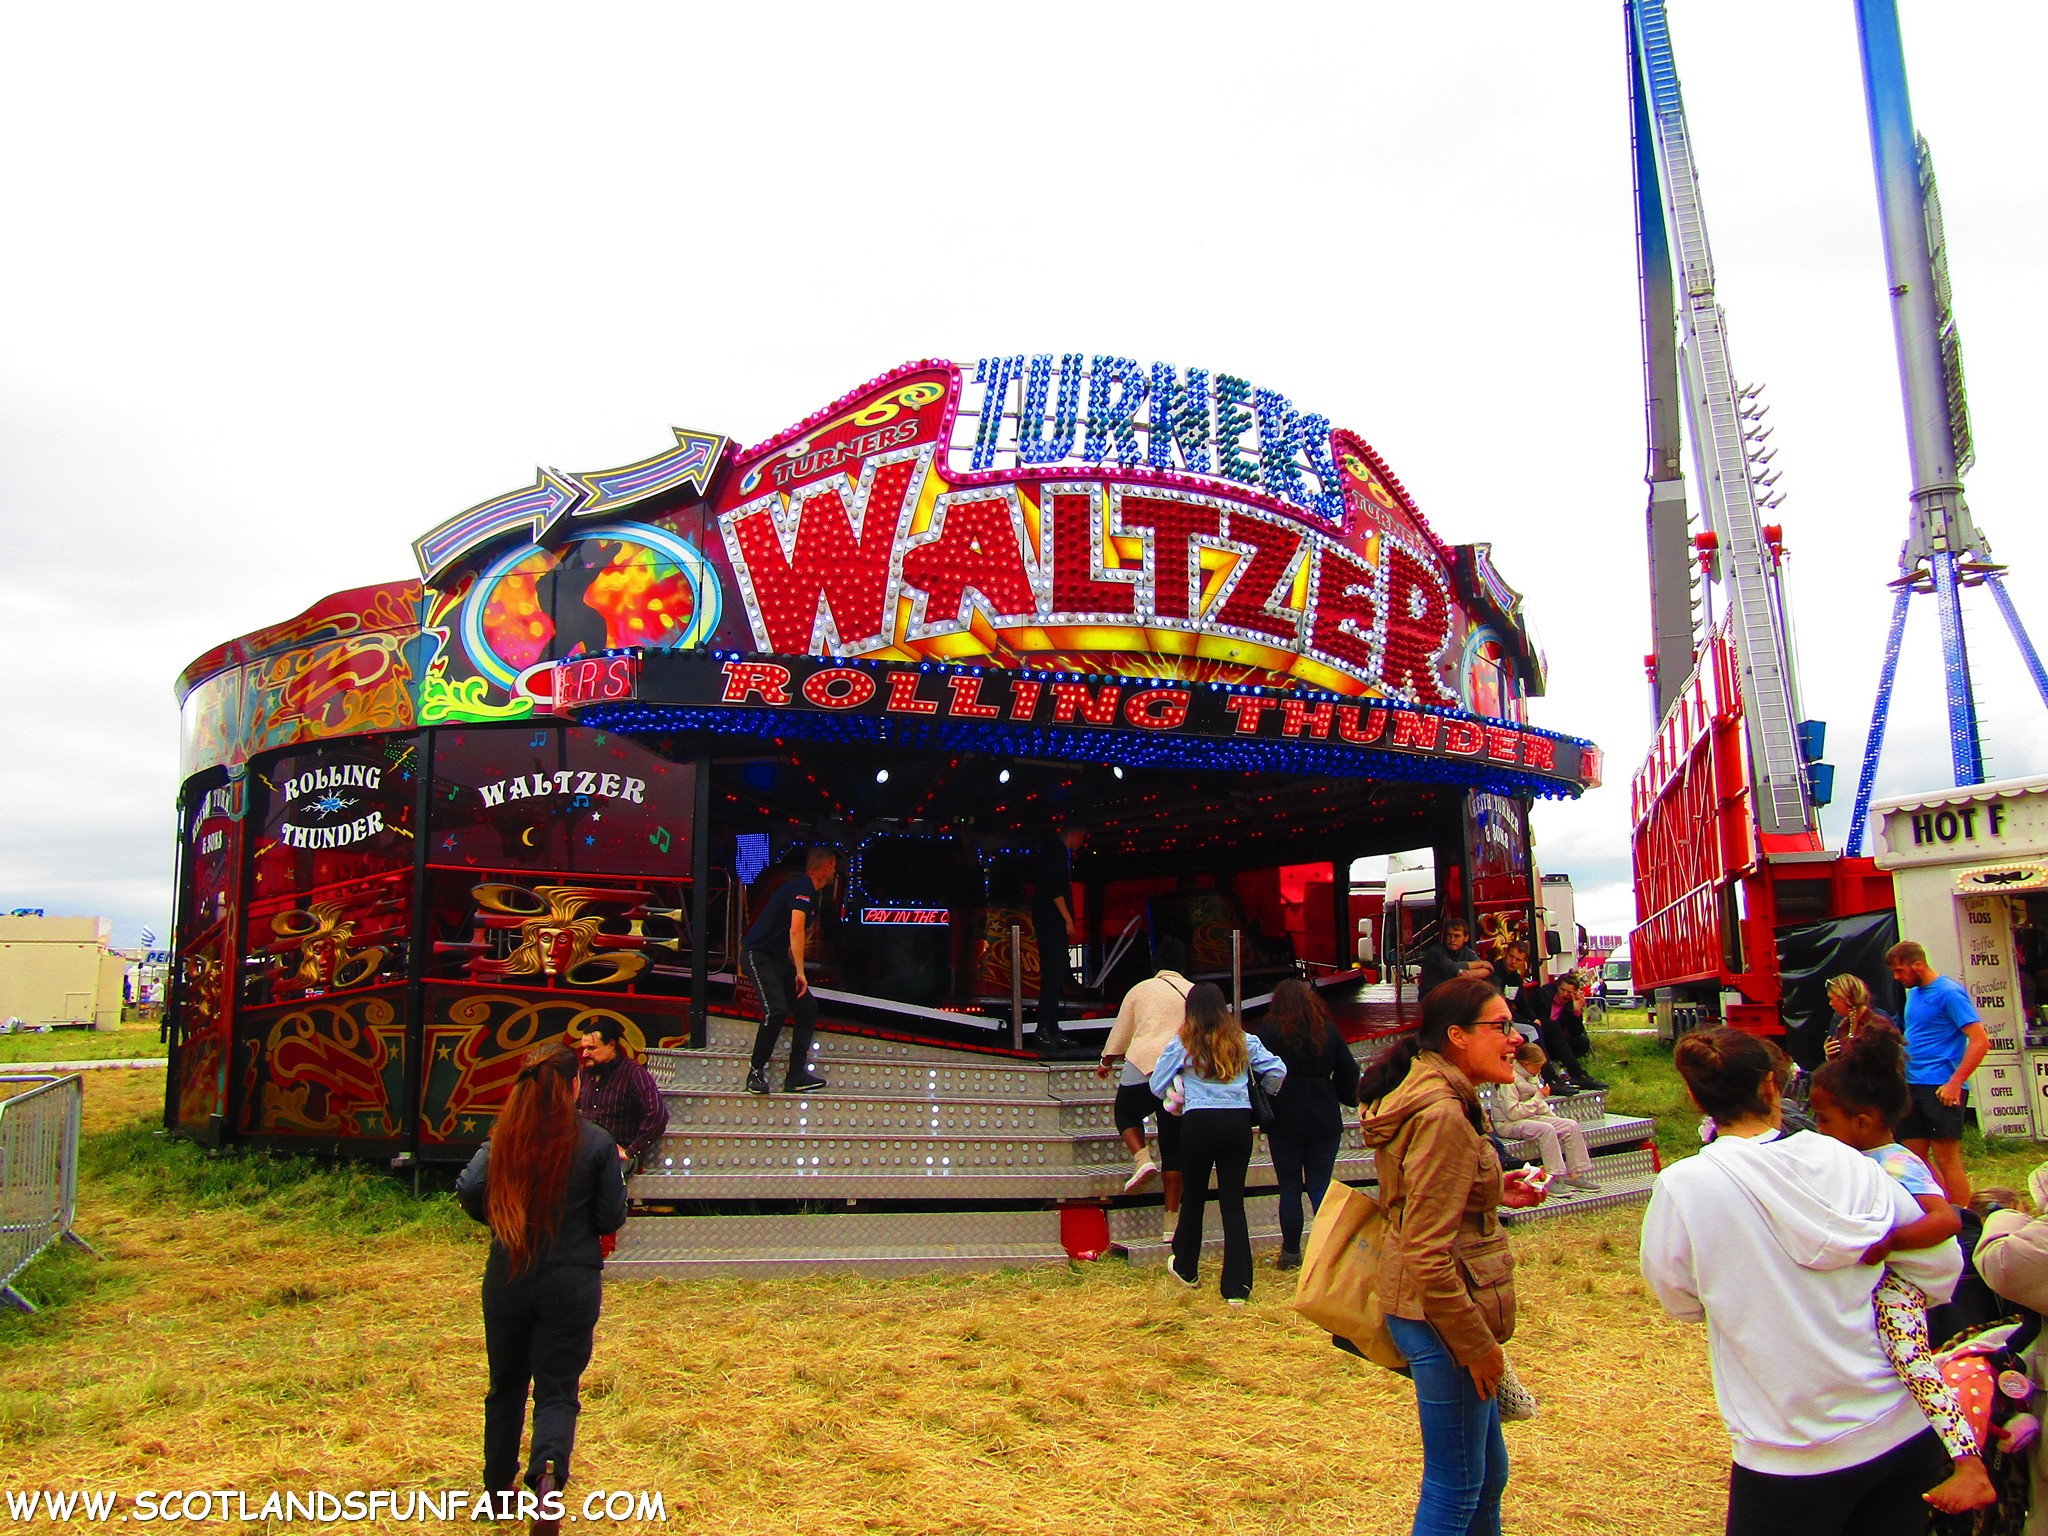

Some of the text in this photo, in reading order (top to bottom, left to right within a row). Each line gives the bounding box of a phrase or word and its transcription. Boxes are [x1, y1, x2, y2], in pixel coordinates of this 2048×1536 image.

[969, 353, 1345, 523] TURNERS
[772, 418, 920, 486] TURNERS
[718, 441, 1466, 710] WALTZER
[721, 661, 1556, 770] ROLLING THUNDER
[284, 764, 381, 802] ROLLING
[478, 770, 646, 808] WALTZER
[282, 811, 384, 849] THUNDER
[1911, 808, 1975, 845] HOT
[865, 910, 891, 923] PAY
[893, 911, 910, 923] IN
[914, 910, 938, 923] THE
[1968, 912, 1992, 924] FLOSS
[1970, 936, 1995, 953] Toffee
[1971, 954, 1999, 966] APPLES
[1970, 979, 2007, 998] Chocolate
[1976, 996, 2005, 1008] APPLES
[1993, 1069, 2006, 1079] TEA
[1991, 1087, 2013, 1097] COFFEE
[1993, 1106, 2028, 1116] CHOCOLATE
[2003, 1123, 2026, 1134] DRINKS
